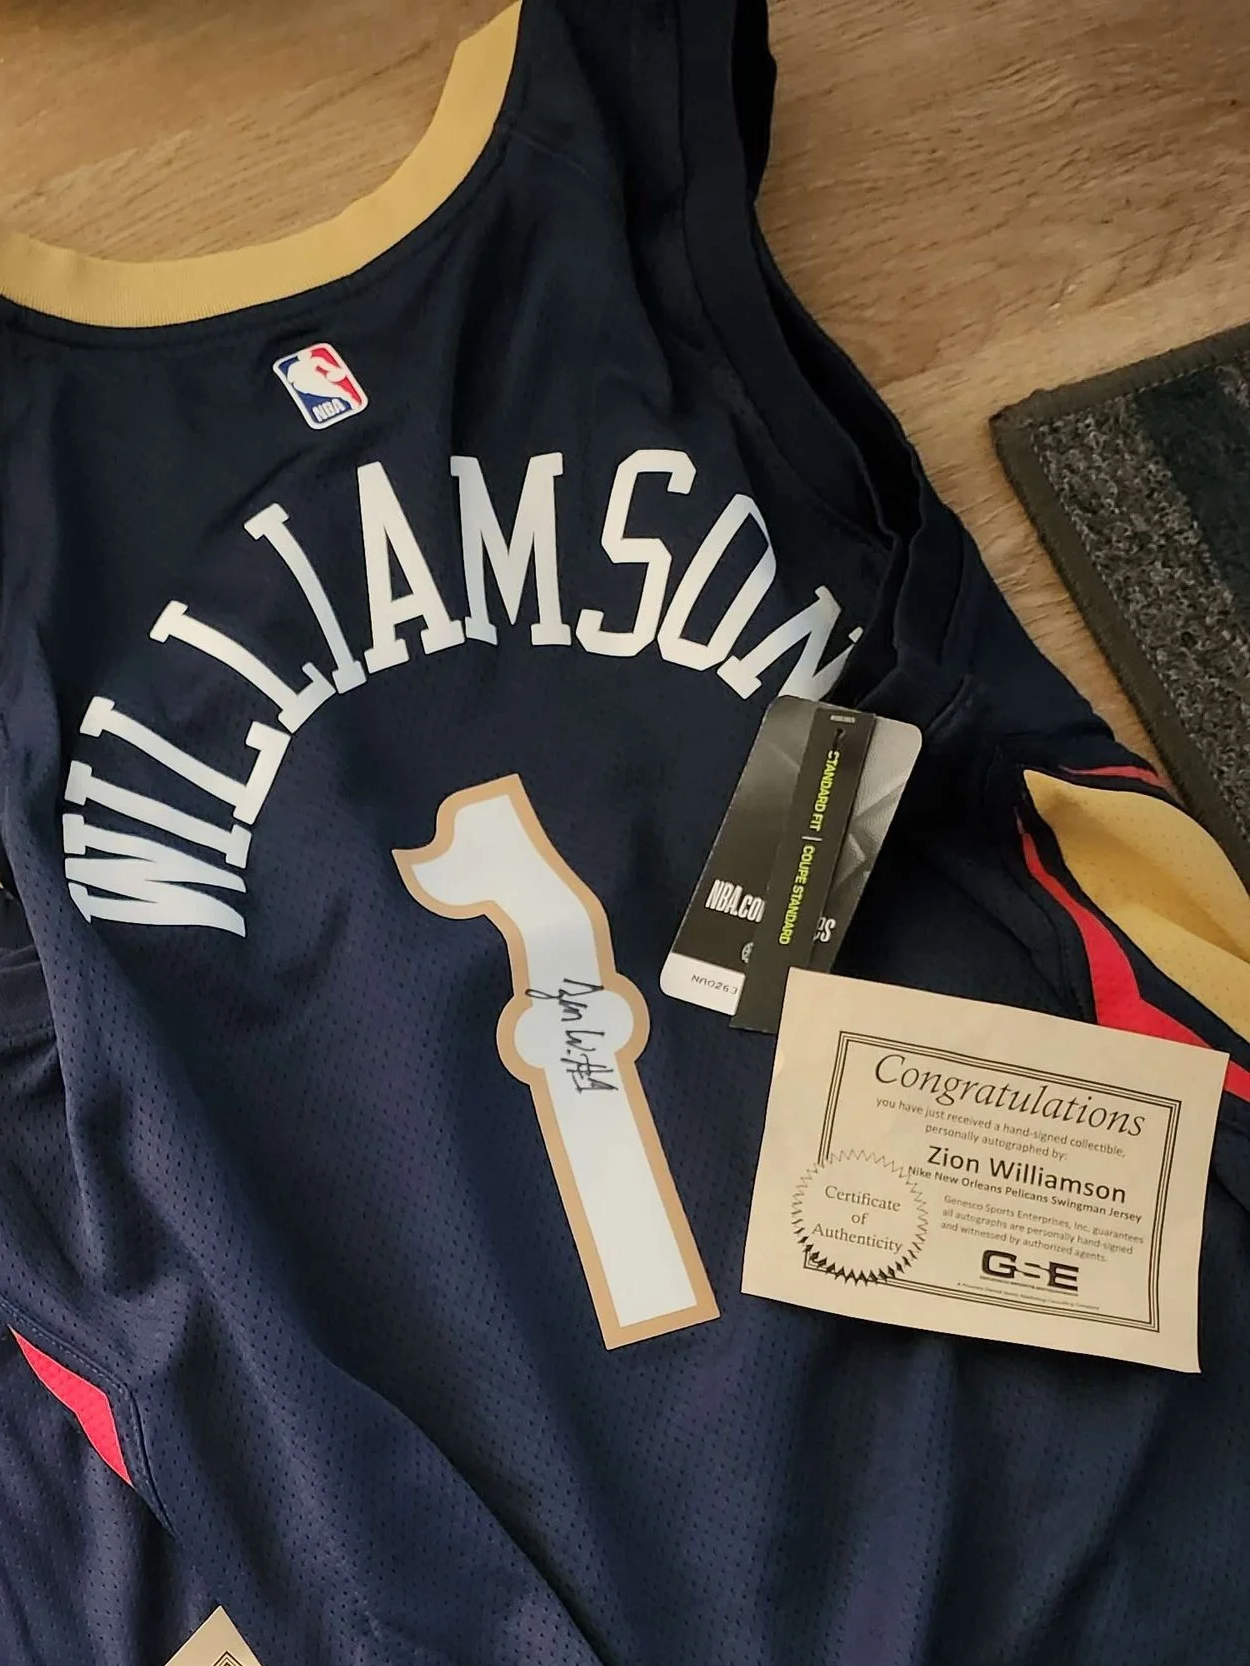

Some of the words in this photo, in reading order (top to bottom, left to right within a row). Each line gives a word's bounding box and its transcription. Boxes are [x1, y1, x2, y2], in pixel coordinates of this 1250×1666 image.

[311, 398, 347, 423] NBA
[63, 449, 863, 937] WILLIAMSON
[809, 813, 824, 832] FIT
[794, 845, 816, 885] COUPE
[778, 884, 804, 945] STANDARD
[392, 773, 721, 1351] 1
[875, 1054, 1146, 1137] Congratulations
[876, 1098, 896, 1109] you
[898, 1100, 924, 1115] have
[924, 1106, 945, 1120] just
[946, 1113, 992, 1129] received
[1002, 1123, 1068, 1145] hand-signed
[925, 1124, 980, 1144] personally
[981, 1136, 1050, 1157] autographed
[908, 1165, 932, 1179] Nike
[934, 1171, 959, 1184] New
[961, 1177, 1002, 1194] Orleans
[1004, 1186, 1049, 1203] Pelicans
[1051, 1195, 1107, 1215] Swingman
[1108, 1207, 1142, 1224] Jersey
[927, 1145, 980, 1174] Zion
[989, 1157, 1126, 1204] Williamson
[824, 1185, 901, 1212] Certificate
[851, 1212, 869, 1226] of
[811, 1222, 903, 1255] Authenticity
